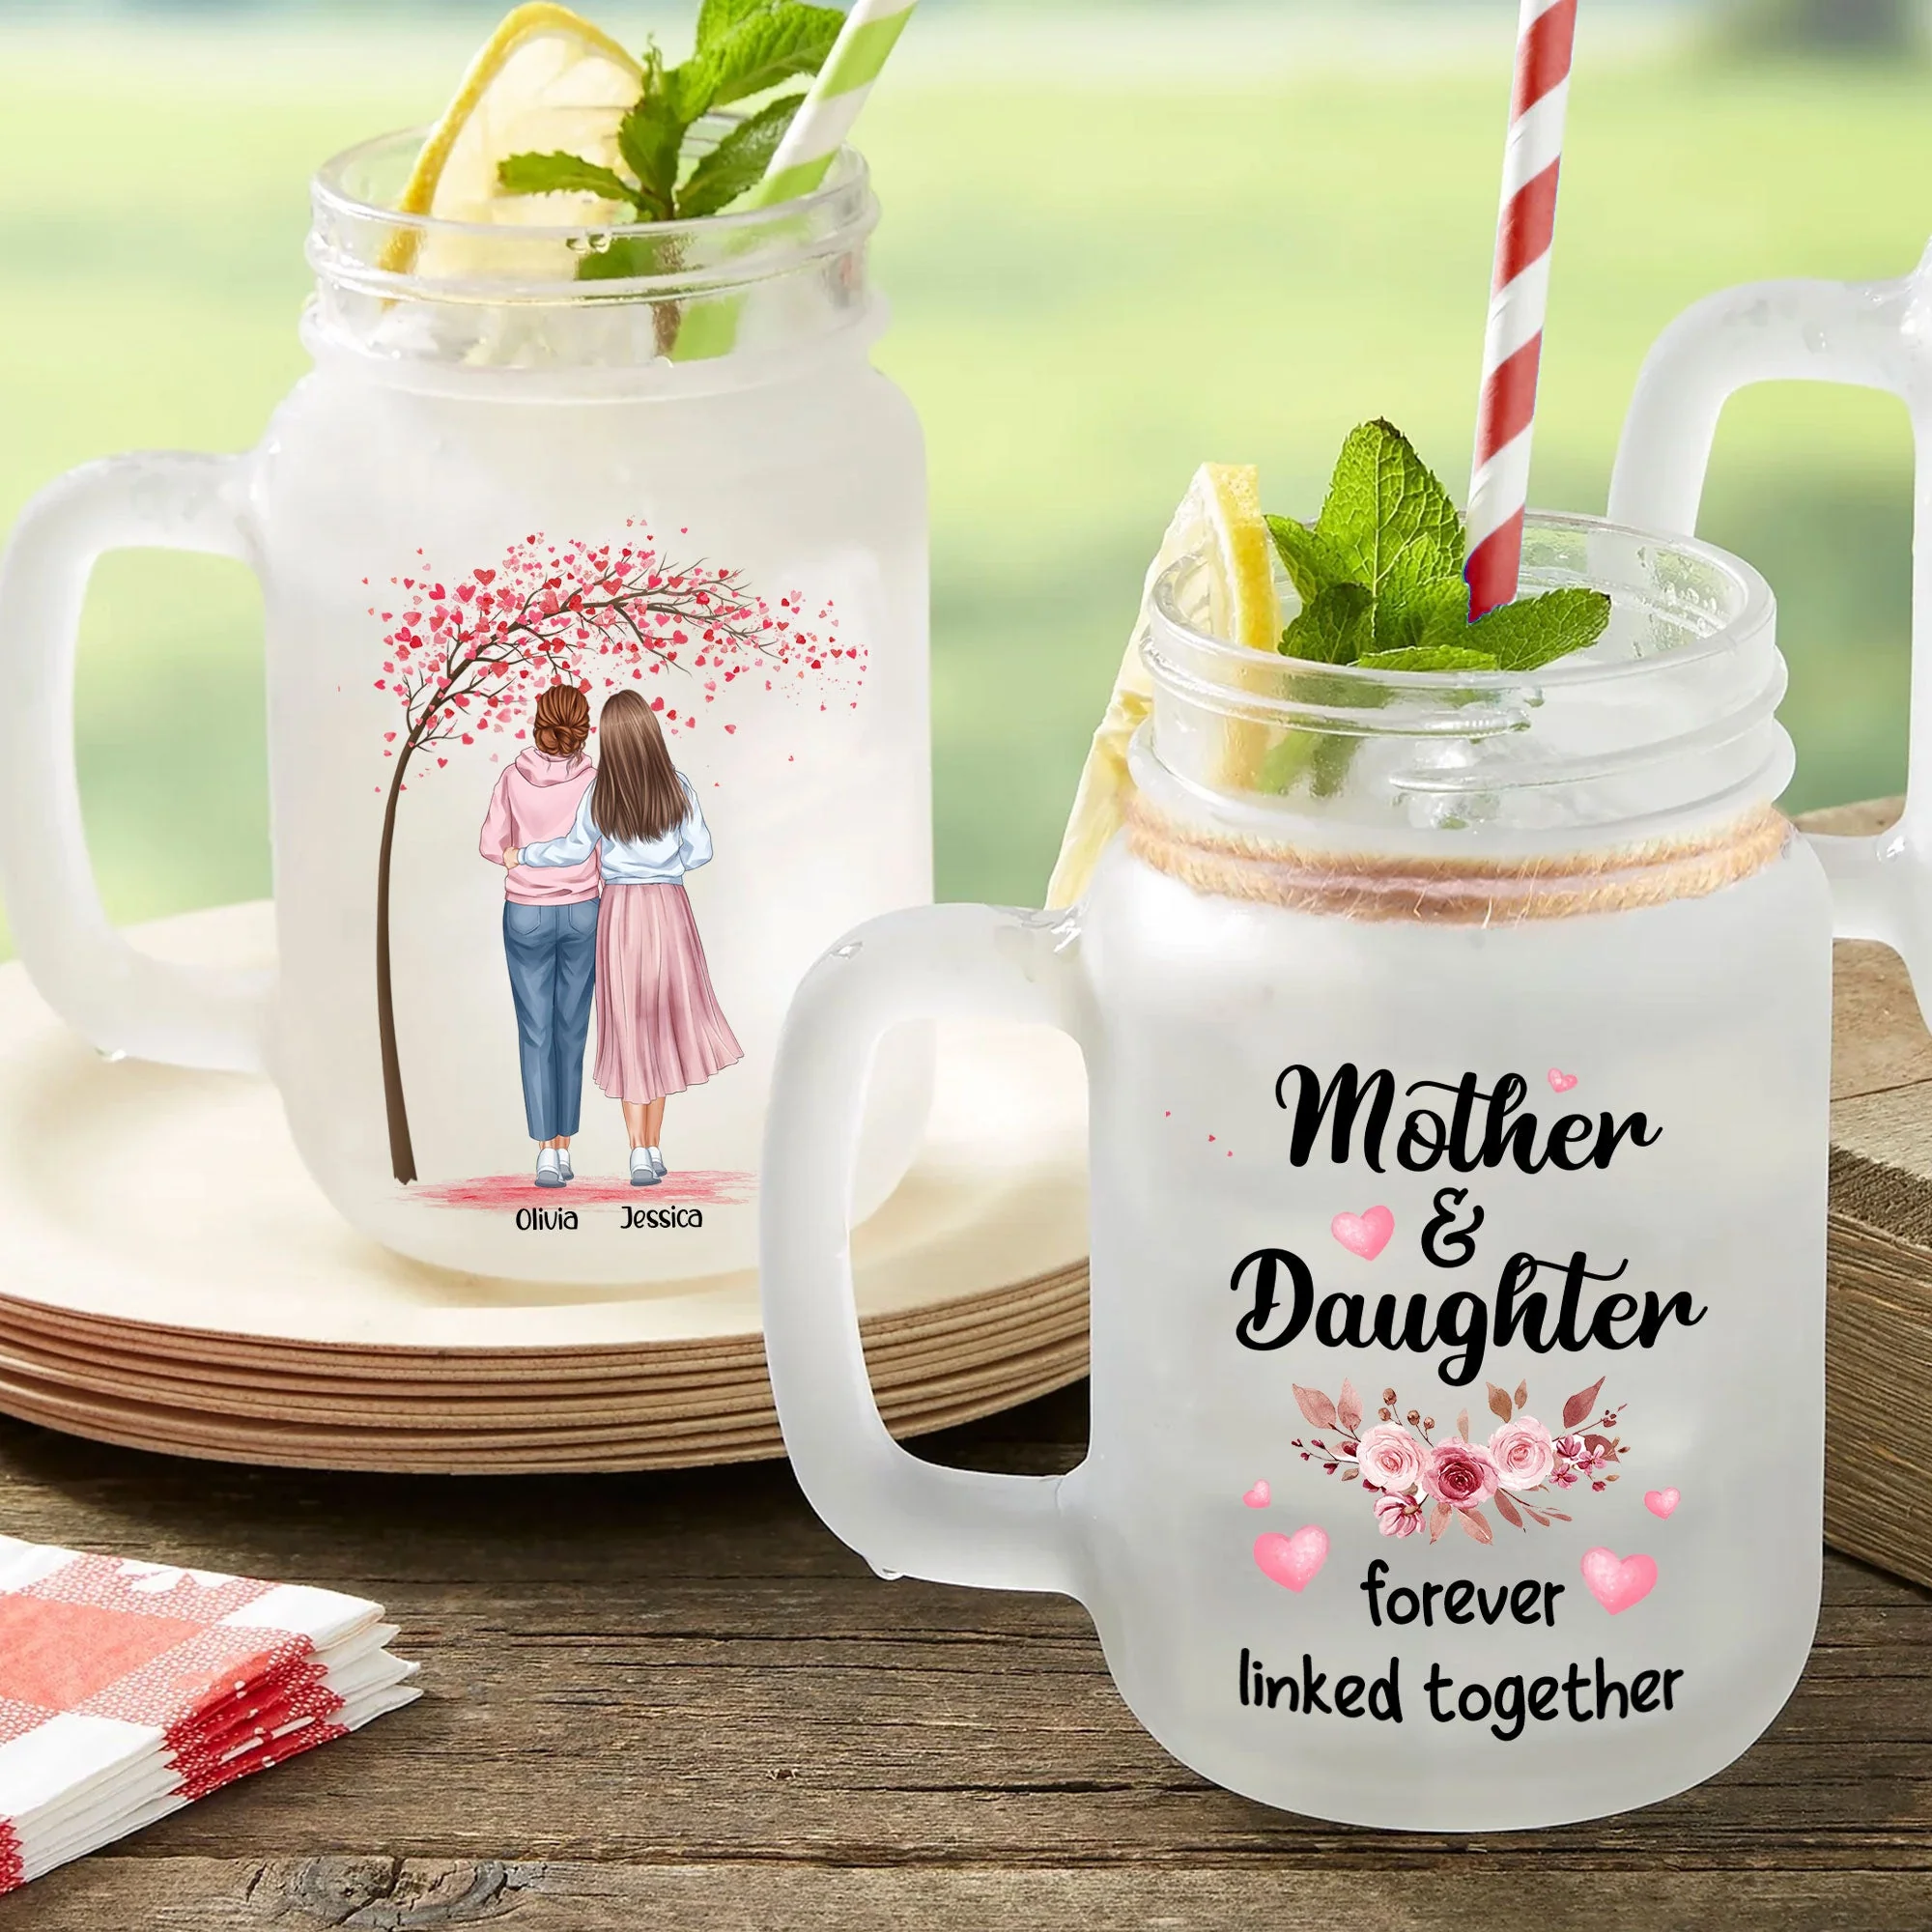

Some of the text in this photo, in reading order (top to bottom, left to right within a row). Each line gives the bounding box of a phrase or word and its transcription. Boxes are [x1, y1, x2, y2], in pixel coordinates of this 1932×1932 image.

[1275, 1063, 1663, 1175] Mother
[515, 1205, 703, 1231] Olivia Jessica
[1420, 1186, 1486, 1268] &
[1230, 1247, 1709, 1387] Daughter
[1359, 1558, 1566, 1628] forever
[1239, 1647, 1685, 1742] linked together
